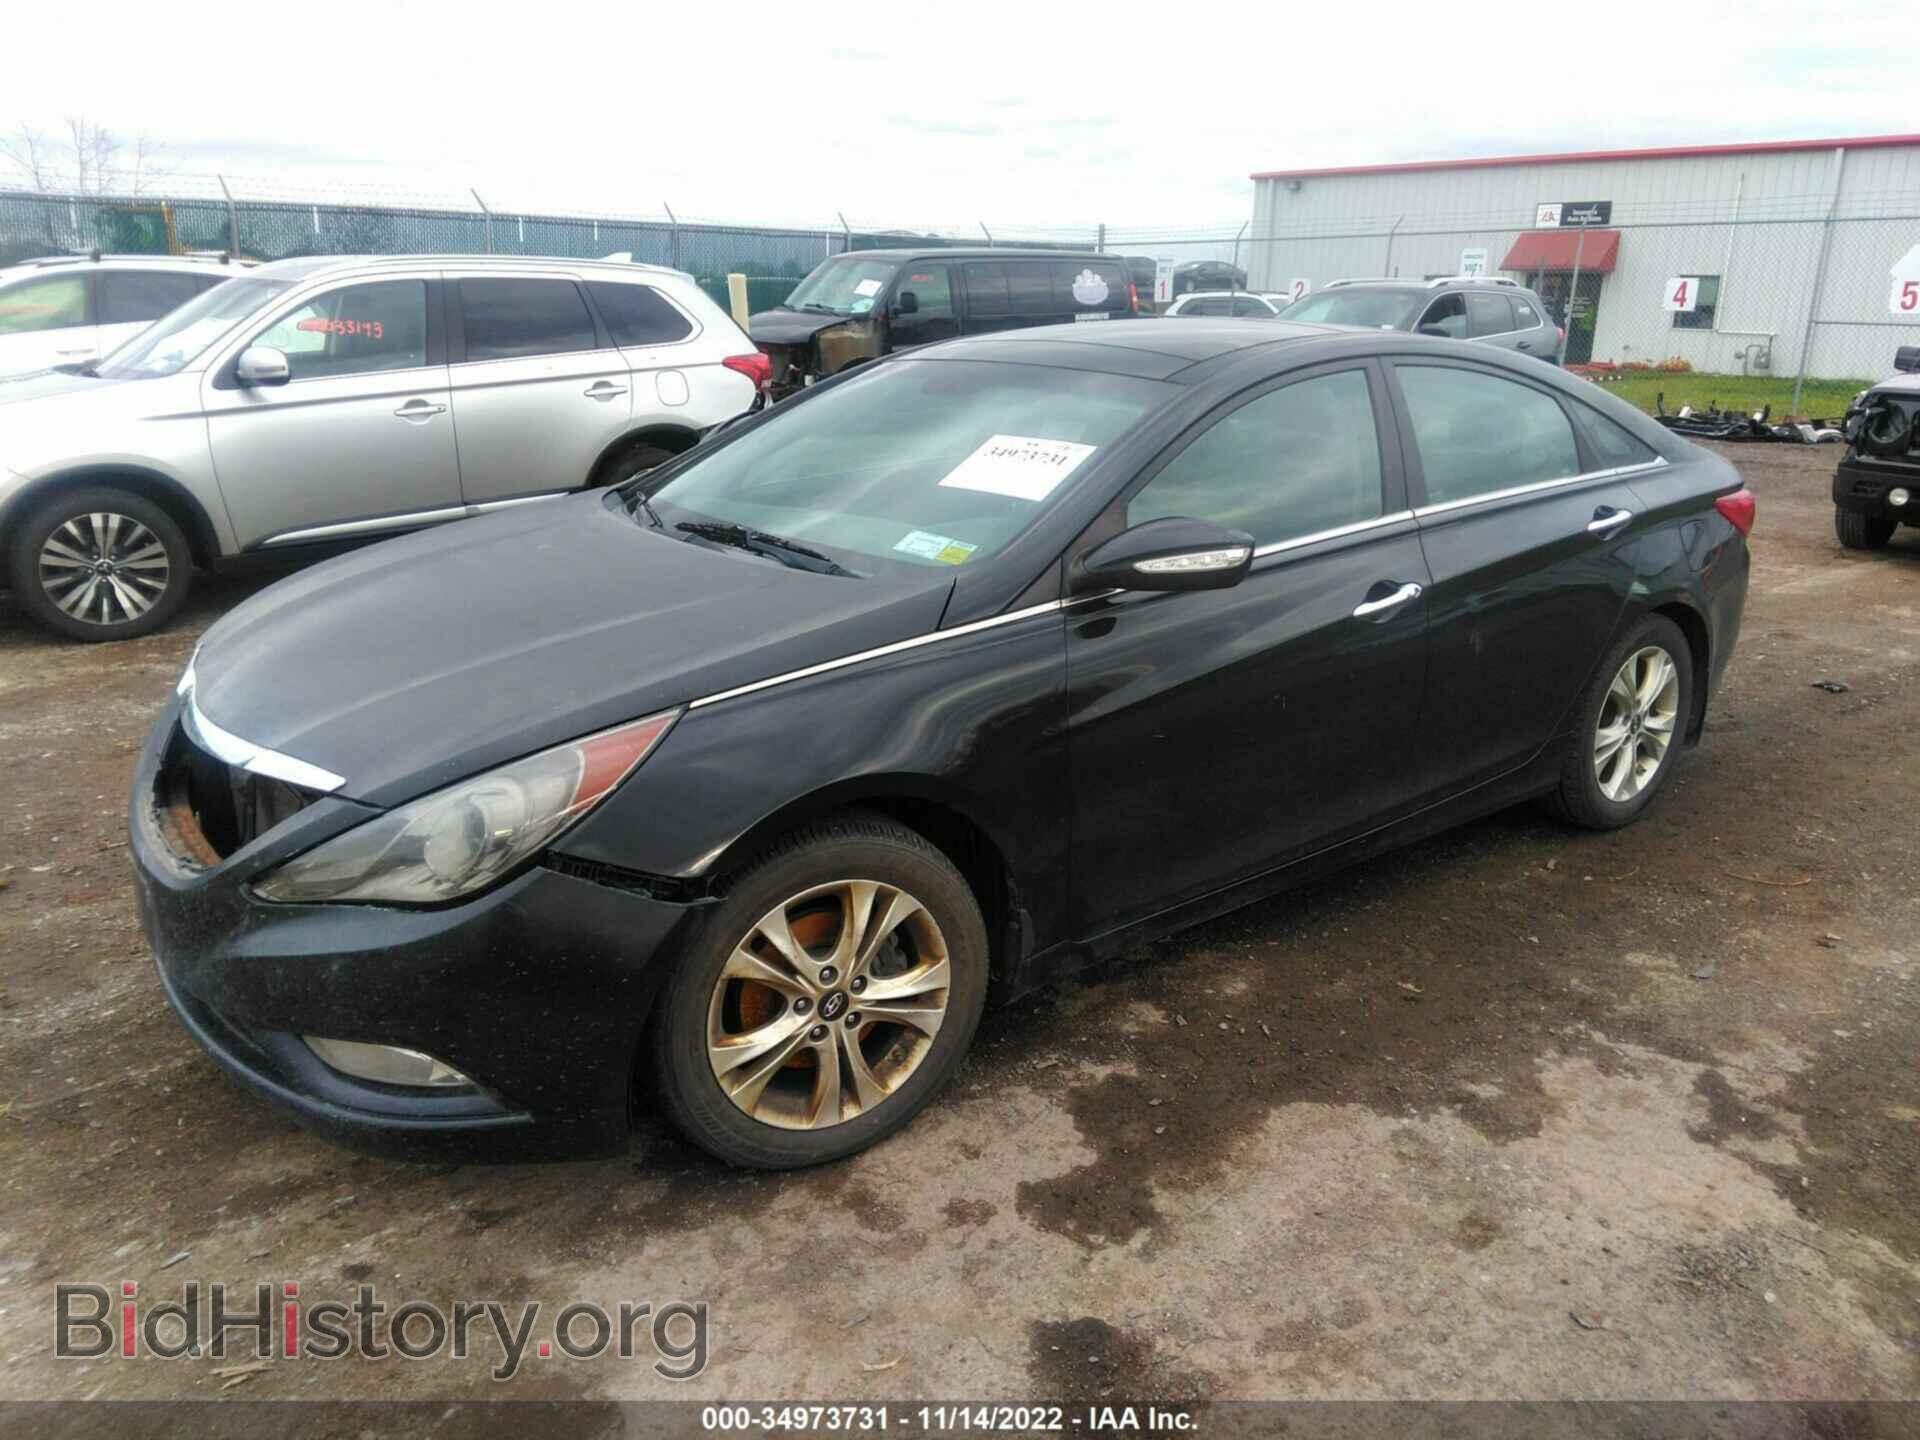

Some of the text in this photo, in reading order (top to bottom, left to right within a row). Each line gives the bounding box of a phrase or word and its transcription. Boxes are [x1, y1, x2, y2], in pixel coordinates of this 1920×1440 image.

[1159, 279, 1167, 300] 1
[1294, 281, 1304, 303] 2
[1672, 281, 1687, 307] 4
[1900, 281, 1920, 310] 5
